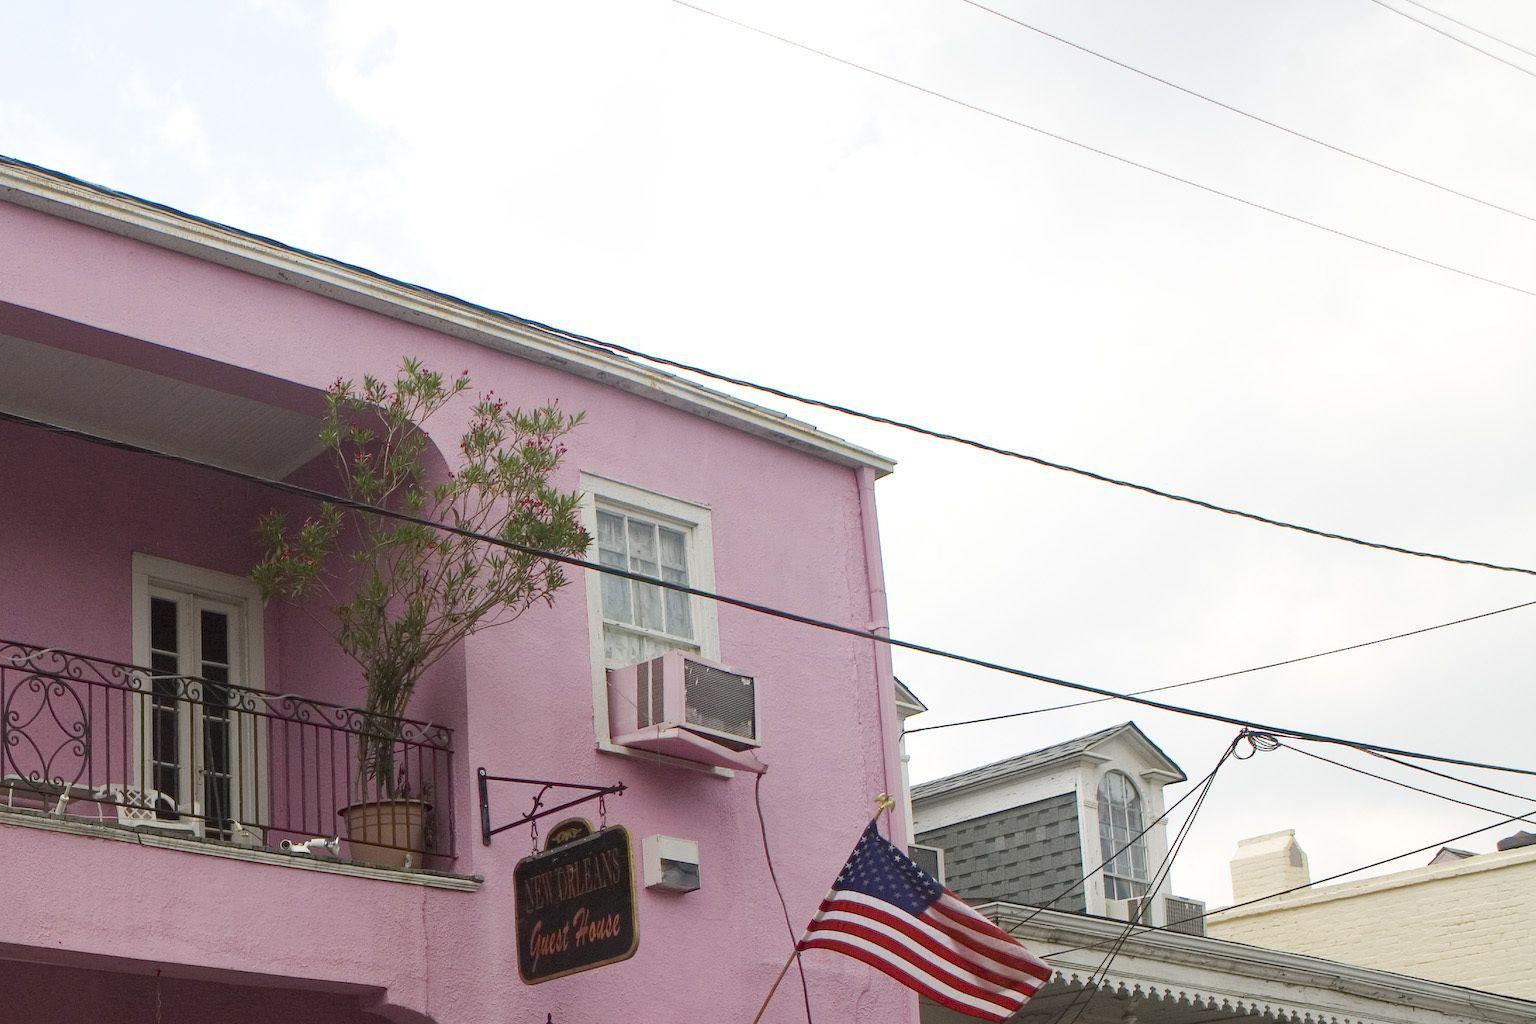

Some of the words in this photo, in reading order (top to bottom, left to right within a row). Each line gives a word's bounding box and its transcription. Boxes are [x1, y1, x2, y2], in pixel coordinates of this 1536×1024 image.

[524, 871, 554, 913] NEW
[557, 848, 621, 901] ORLEANS
[530, 919, 570, 973] Guest
[573, 906, 621, 946] House
